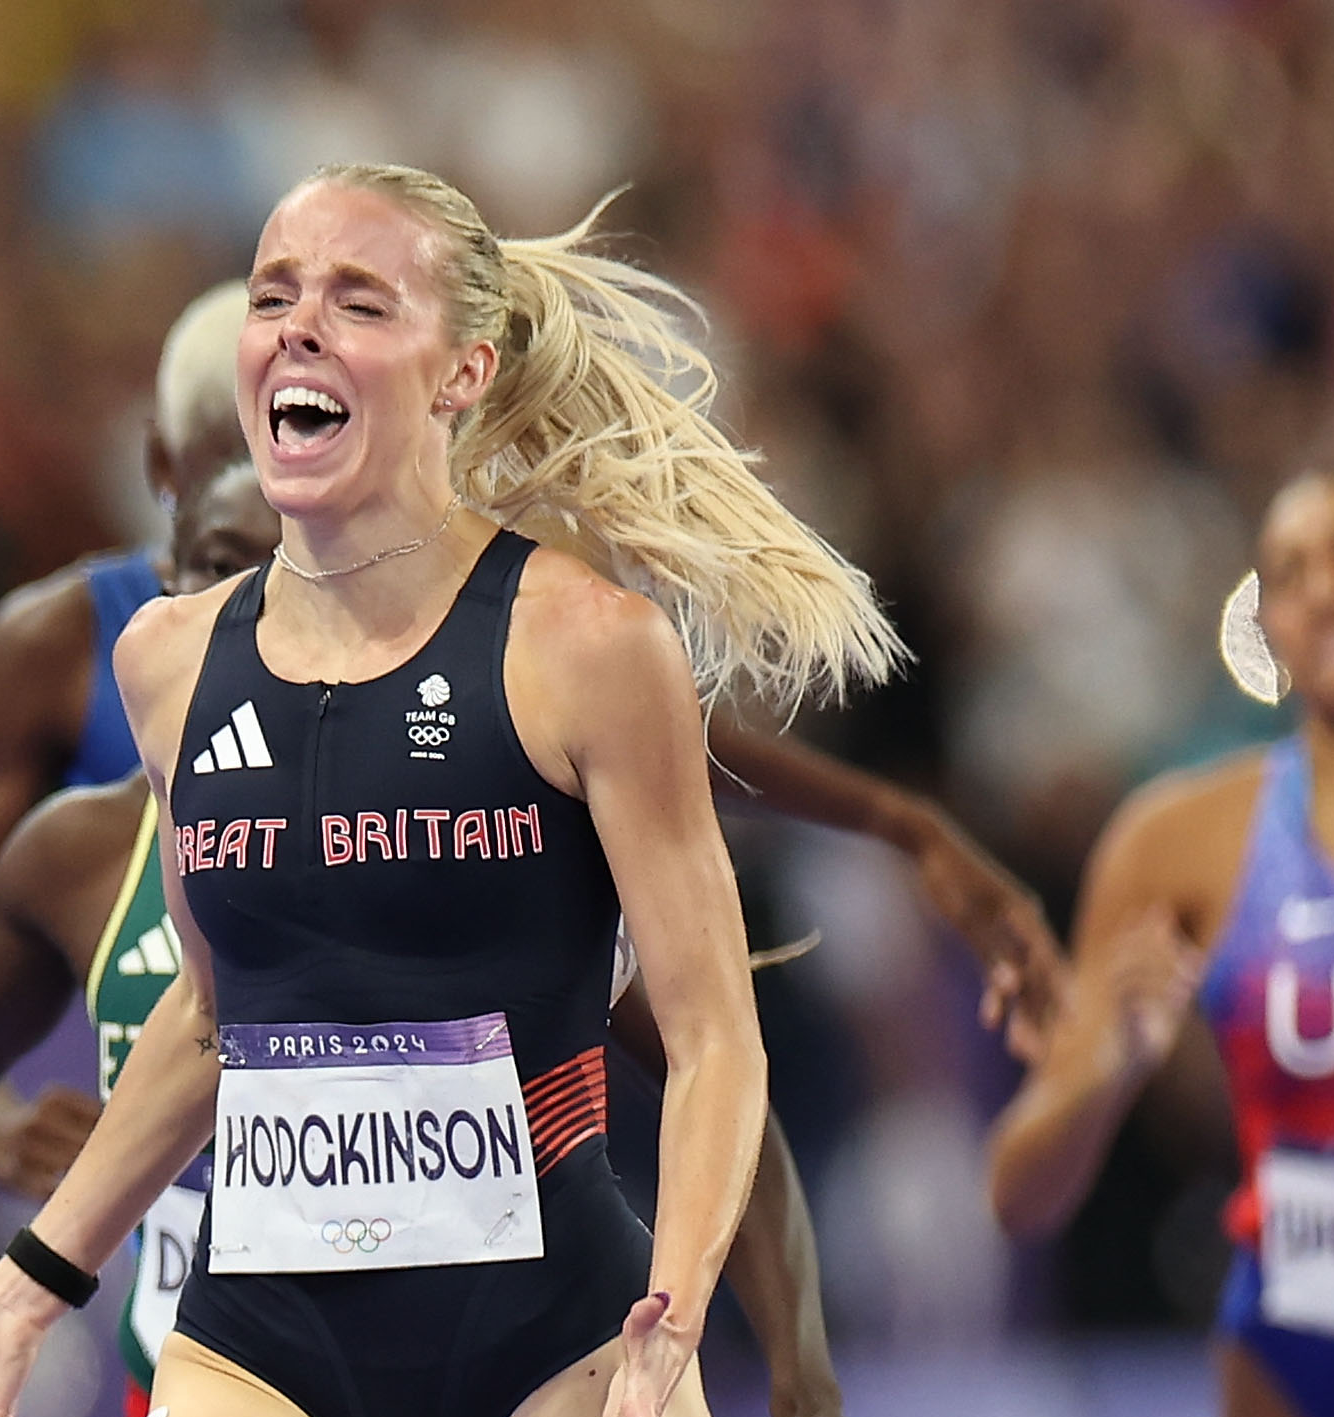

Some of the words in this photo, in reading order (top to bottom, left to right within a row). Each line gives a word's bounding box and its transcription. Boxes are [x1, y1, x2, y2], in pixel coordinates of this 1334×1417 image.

[405, 710, 436, 722] TEAM
[438, 712, 455, 726] GB
[175, 819, 286, 876] REAT
[321, 803, 542, 866] BRITAIN
[268, 1035, 343, 1057] PARIS
[352, 1033, 426, 1054] 2024
[224, 1104, 523, 1188] HODGKINSON
